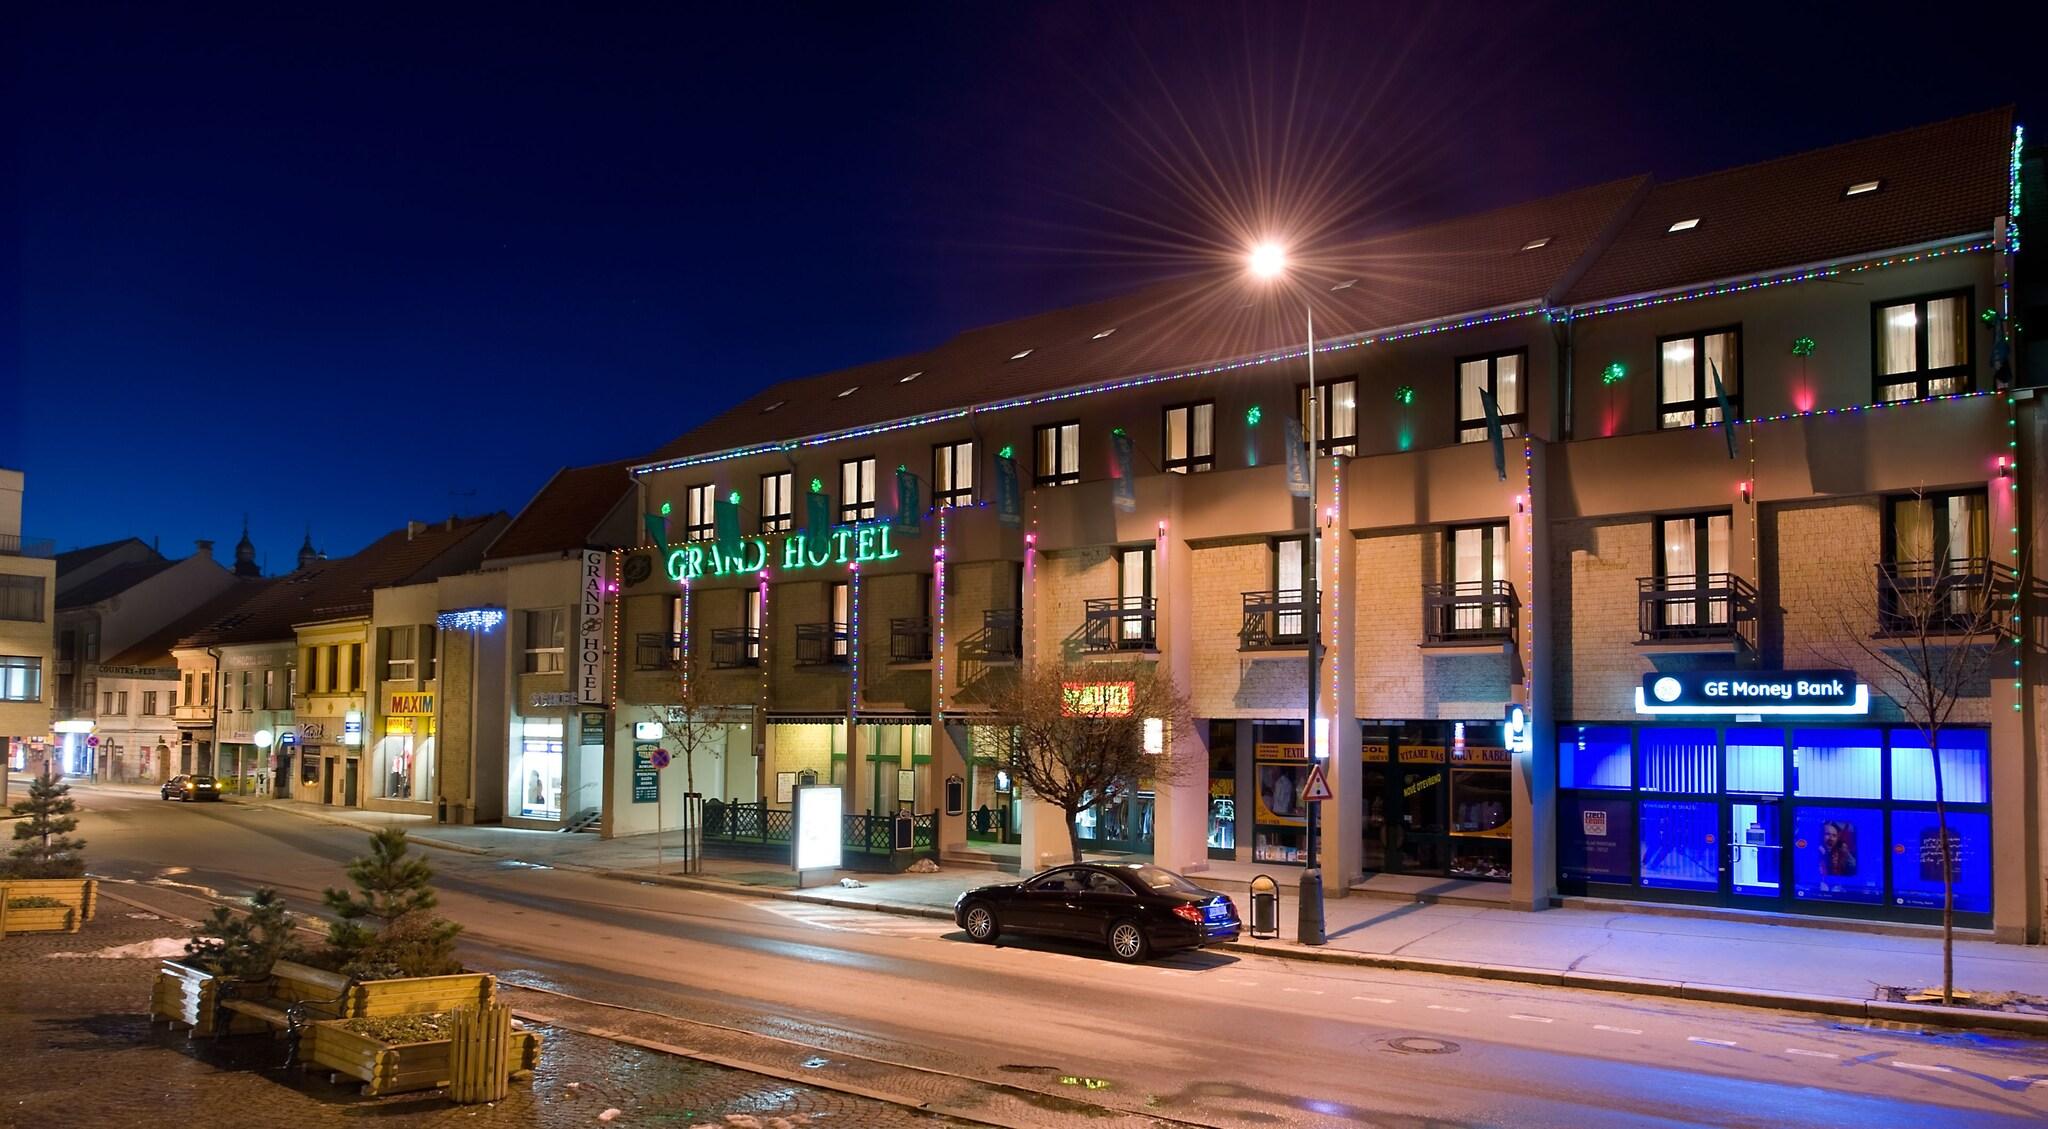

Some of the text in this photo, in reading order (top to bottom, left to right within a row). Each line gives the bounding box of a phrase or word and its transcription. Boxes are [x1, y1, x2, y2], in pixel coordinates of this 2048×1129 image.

[667, 526, 899, 581] GRAND HOTEL
[585, 553, 601, 616] GRAND
[583, 638, 599, 701] HOTEL
[392, 696, 433, 713] MAXIM
[1704, 680, 1844, 700] GE Money Bank
[1482, 749, 1511, 761] KABEL
